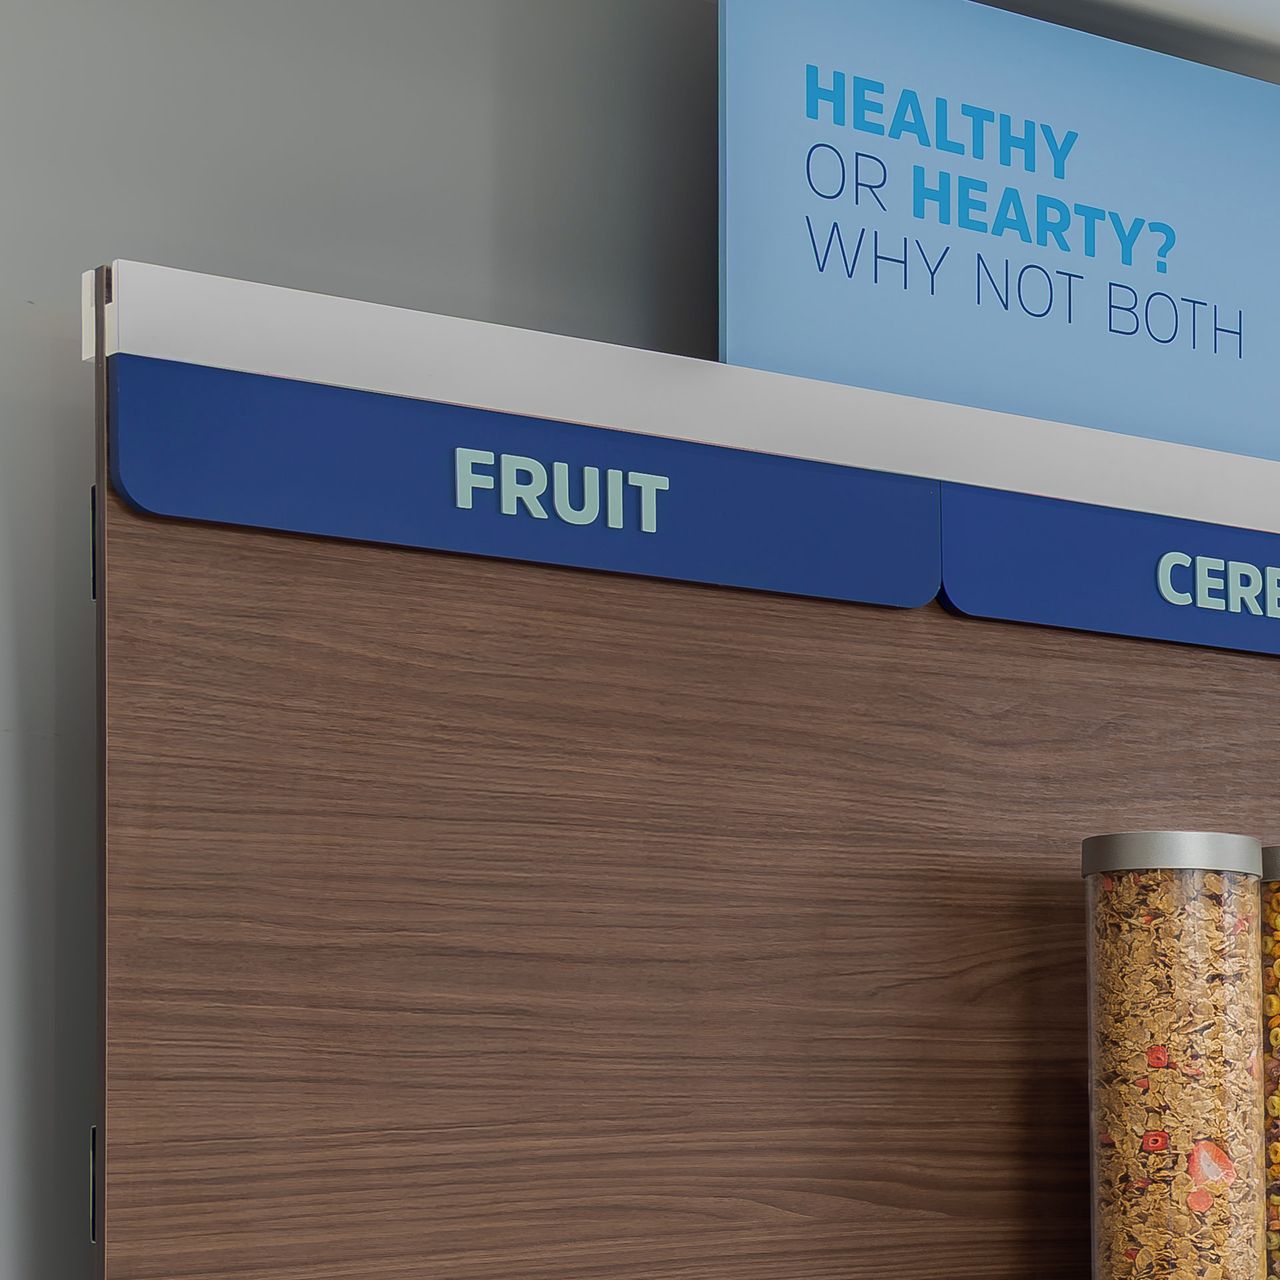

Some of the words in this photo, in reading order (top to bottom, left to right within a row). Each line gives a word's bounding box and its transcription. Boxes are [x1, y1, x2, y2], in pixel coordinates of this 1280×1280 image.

[805, 64, 1078, 180] HEALTHY
[805, 142, 888, 212] OR
[912, 164, 1176, 274] HEARTY?
[805, 215, 950, 296] WHY
[975, 252, 1084, 324] NOT
[1108, 281, 1243, 359] BOTH
[454, 446, 670, 534] FRUIT
